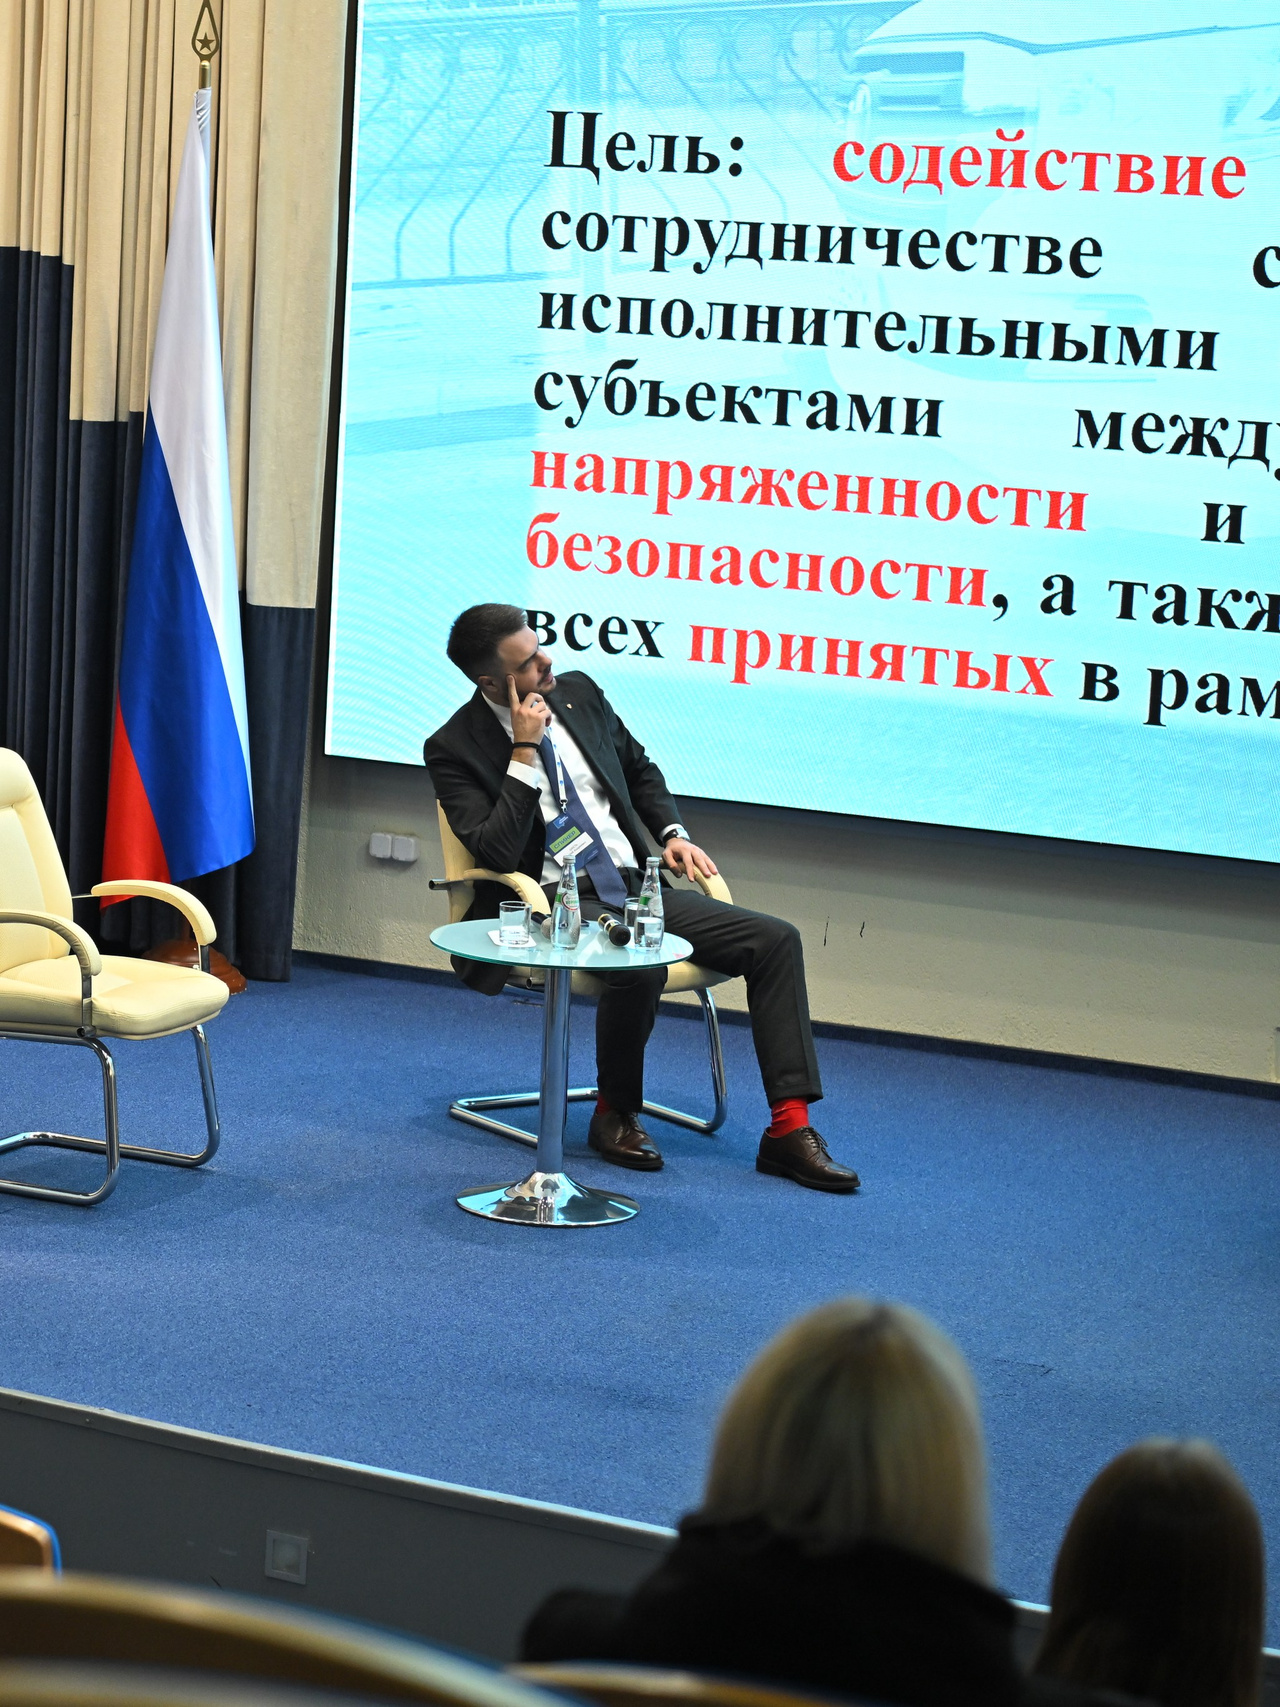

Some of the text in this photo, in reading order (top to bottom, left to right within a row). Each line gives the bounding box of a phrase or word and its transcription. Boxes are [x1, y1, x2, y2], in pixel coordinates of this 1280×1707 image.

[544, 111, 1245, 198] Цель: содействие
[543, 211, 1102, 278] сотрудничестве
[538, 293, 1219, 371] исполнительными
[535, 360, 1280, 481] субъектами межд
[532, 451, 1247, 544] напряженности и
[527, 513, 1280, 633] безопасности, а такж
[526, 609, 1280, 726] всех принятых в рам
